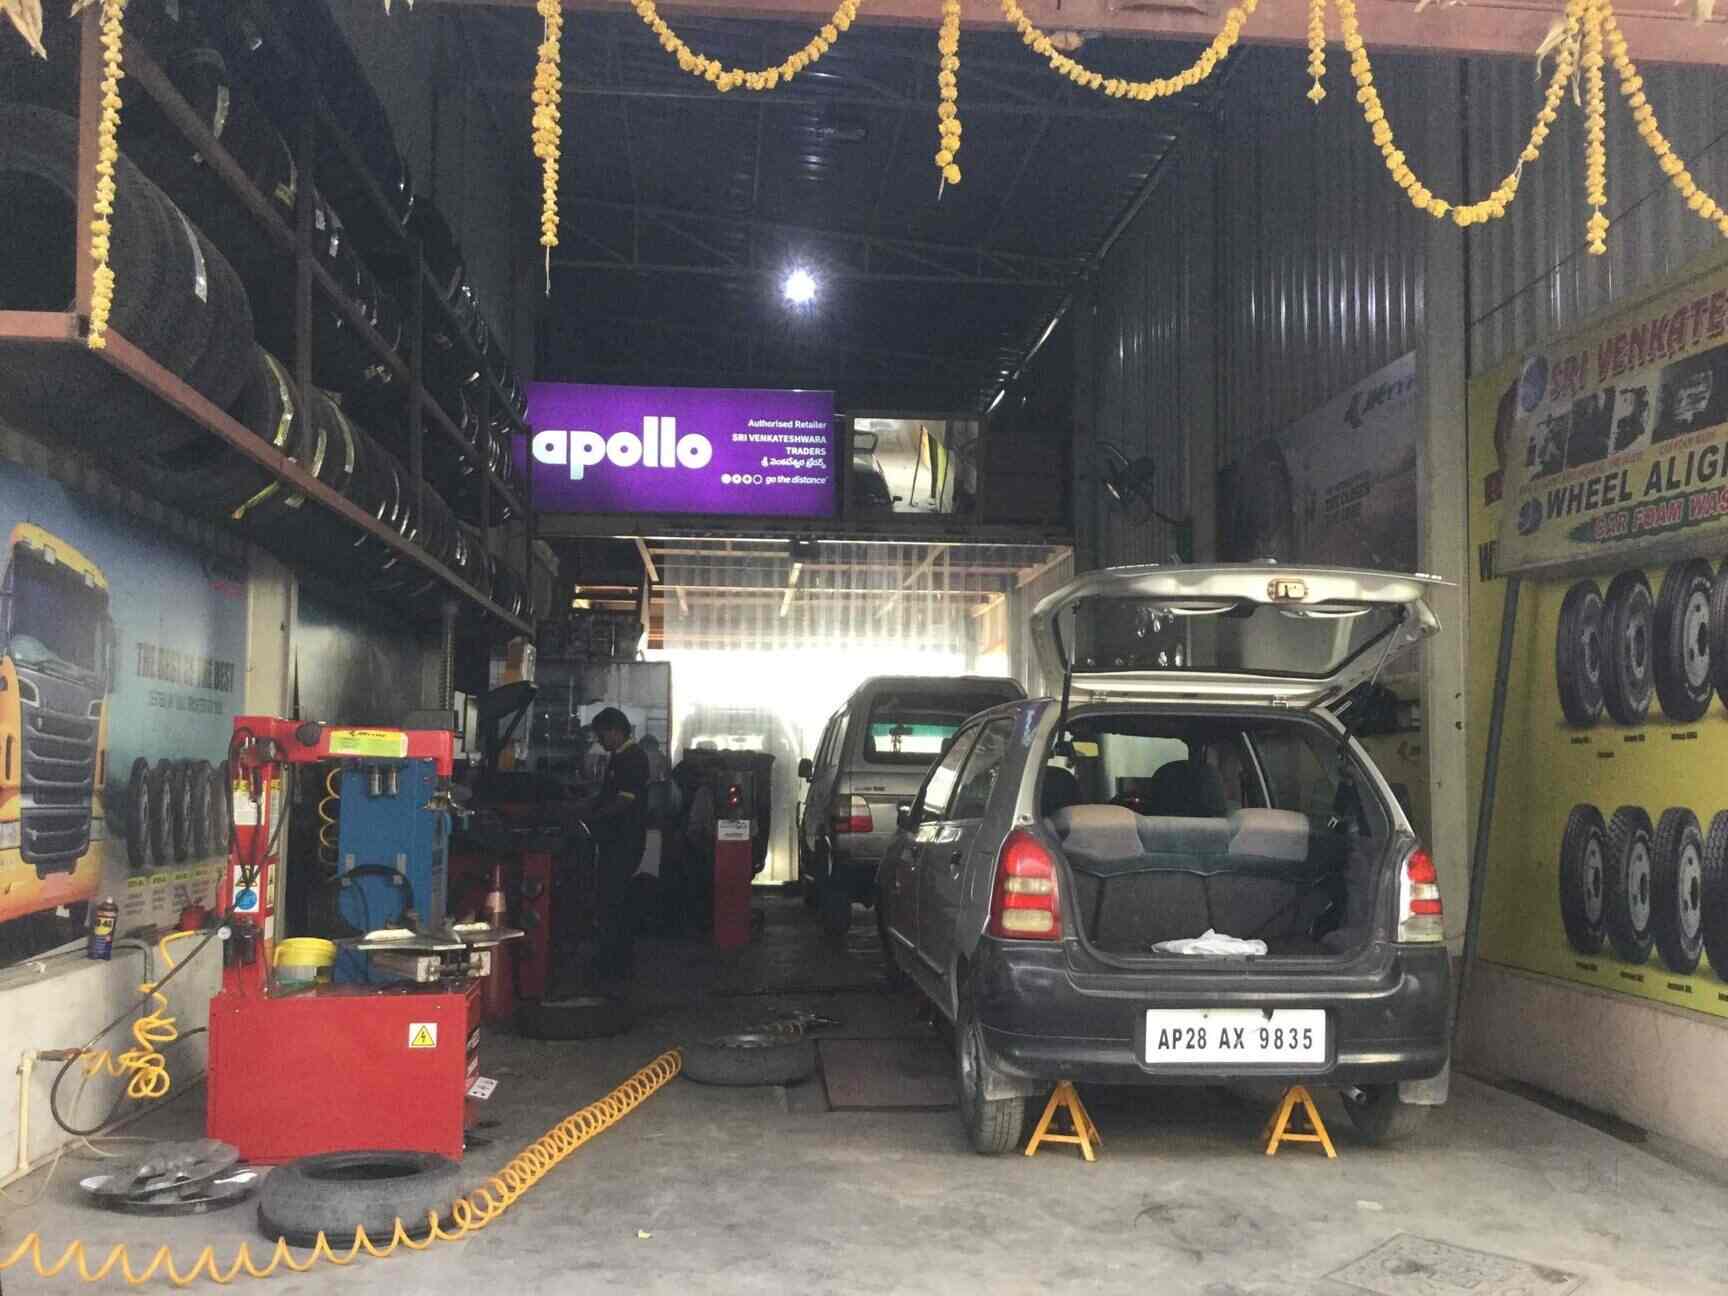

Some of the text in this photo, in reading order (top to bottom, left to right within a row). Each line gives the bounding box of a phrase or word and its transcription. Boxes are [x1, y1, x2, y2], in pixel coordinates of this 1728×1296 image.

[1598, 288, 1728, 384] VENKATE
[748, 419, 827, 429] Authorised Retailer
[732, 433, 827, 443] SRI VENKATESHWARA
[532, 416, 712, 480] apollo
[785, 447, 827, 456] TRADERS
[765, 475, 827, 485] go the distance
[1547, 470, 1633, 520] WHEEL
[1158, 1028, 1313, 1050] AP28 AX 9835
